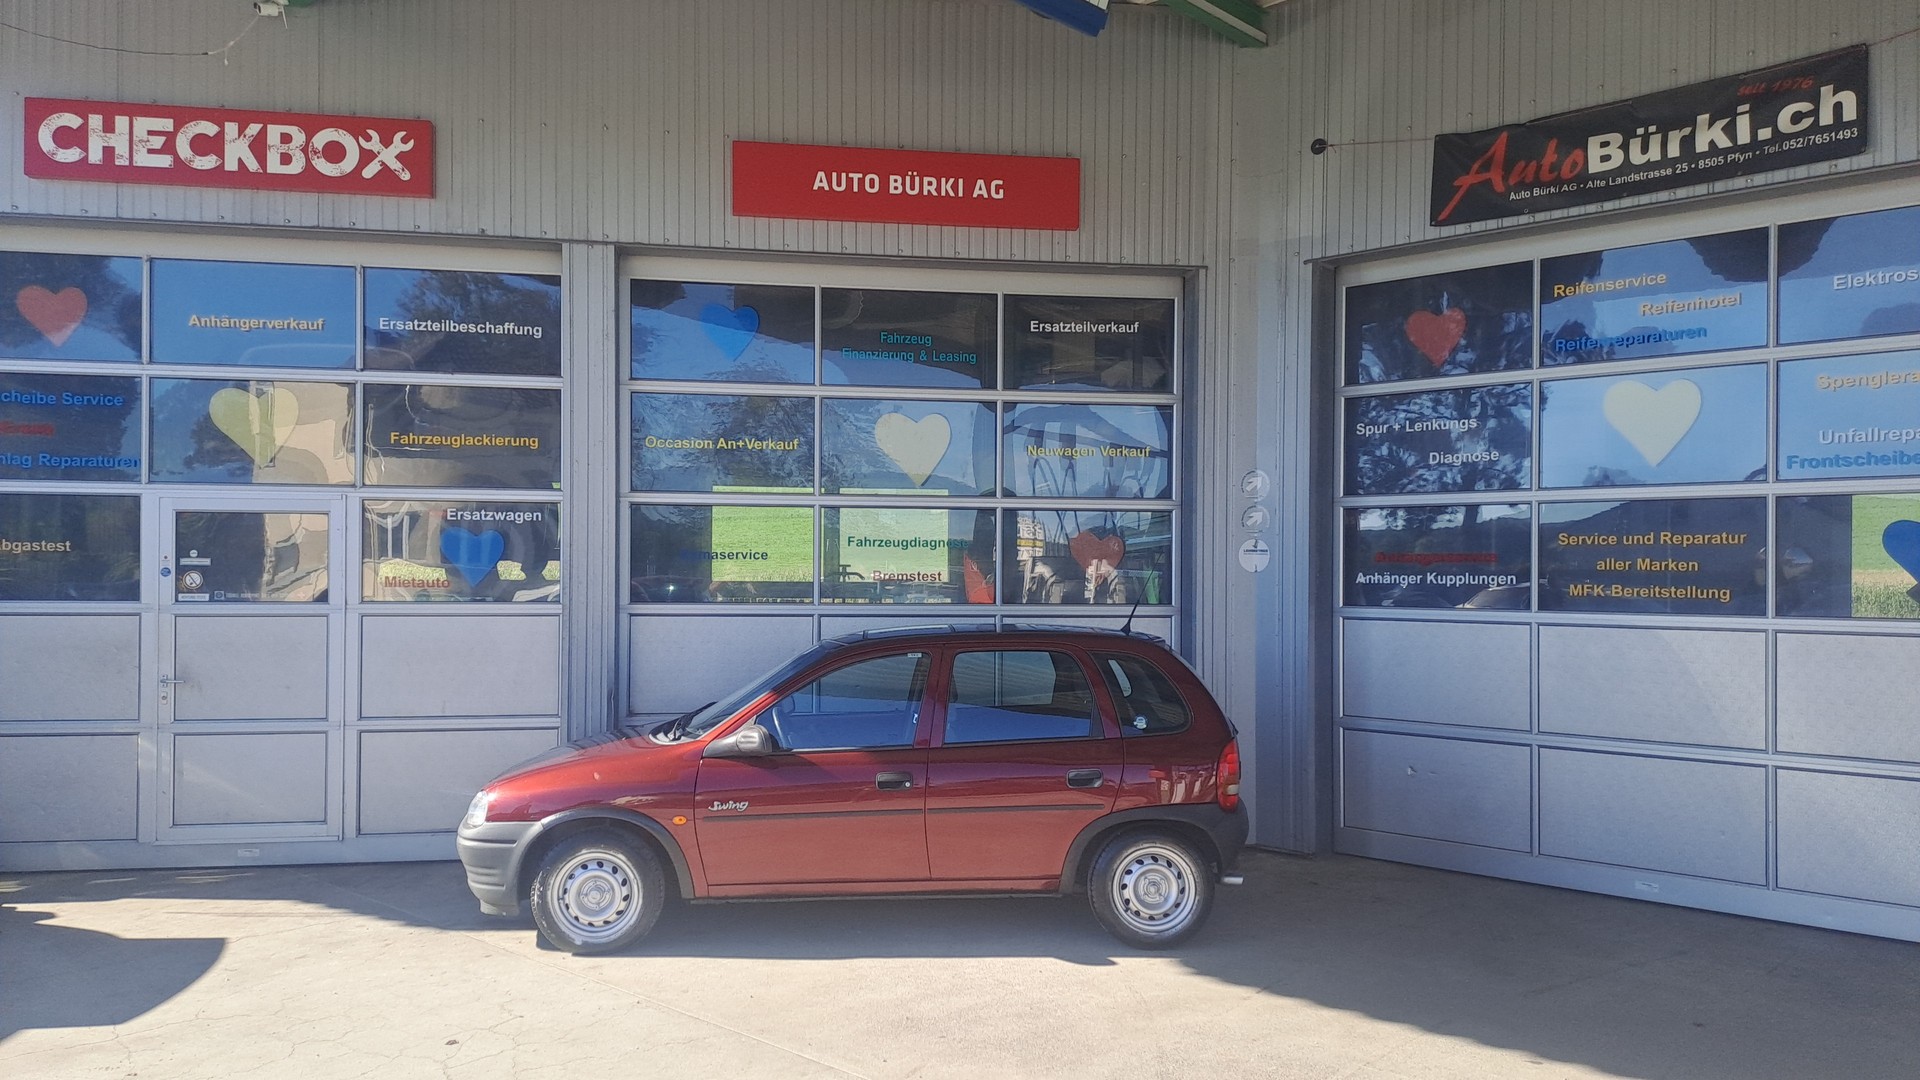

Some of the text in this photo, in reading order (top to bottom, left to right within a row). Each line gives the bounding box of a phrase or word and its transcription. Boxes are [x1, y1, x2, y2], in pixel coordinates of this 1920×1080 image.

[1771, 76, 1815, 92] 1976
[813, 170, 1005, 199] AUTO BÜRKI AG
[1509, 189, 1531, 201] Auto
[1533, 185, 1559, 197] Bürki
[1561, 183, 1577, 193] AG
[1586, 179, 1606, 189] Alte
[1609, 167, 1672, 186] Landstrasse
[1675, 163, 1689, 174] 25
[1698, 156, 1724, 170] 8505
[1728, 151, 1753, 165] Pfyn
[1553, 271, 1667, 298] Reifenservice
[1833, 268, 1920, 291] Elektros
[1639, 292, 1742, 317] Reifenhotel
[189, 314, 327, 332] Anhängerverkauf
[379, 317, 543, 339] Ersatzteilbeschaffung
[1029, 319, 1140, 336] Ersatzteilverkauf
[880, 331, 933, 347] Fahrzeug
[1555, 326, 1708, 353] Reifeeparaturen
[841, 347, 977, 364] Finanzierung & Leasing
[62, 392, 123, 406] Service
[1356, 415, 1478, 437] Spur + Lenkungs
[390, 431, 540, 450] Fahrzeuglackierung
[644, 435, 799, 452] Occasion An+Verkauf
[1027, 445, 1151, 459] Neuwagen Verkauf
[1429, 448, 1500, 466] Diagnose
[39, 453, 140, 469] Reparaturen
[446, 508, 542, 524] Ersatzwagen
[0, 539, 71, 554] bgastest
[847, 536, 969, 551] Fahrzeugdiagnose
[1558, 531, 1747, 548] Service und Reparatur
[1596, 557, 1699, 572] aller Marken
[384, 576, 451, 589] Mietauto
[873, 571, 942, 582] Bremstest
[1356, 572, 1517, 588] Anhänger Kupplungen
[1568, 584, 1731, 603] MFK-Bereitstellung
[708, 800, 749, 812] Swing
